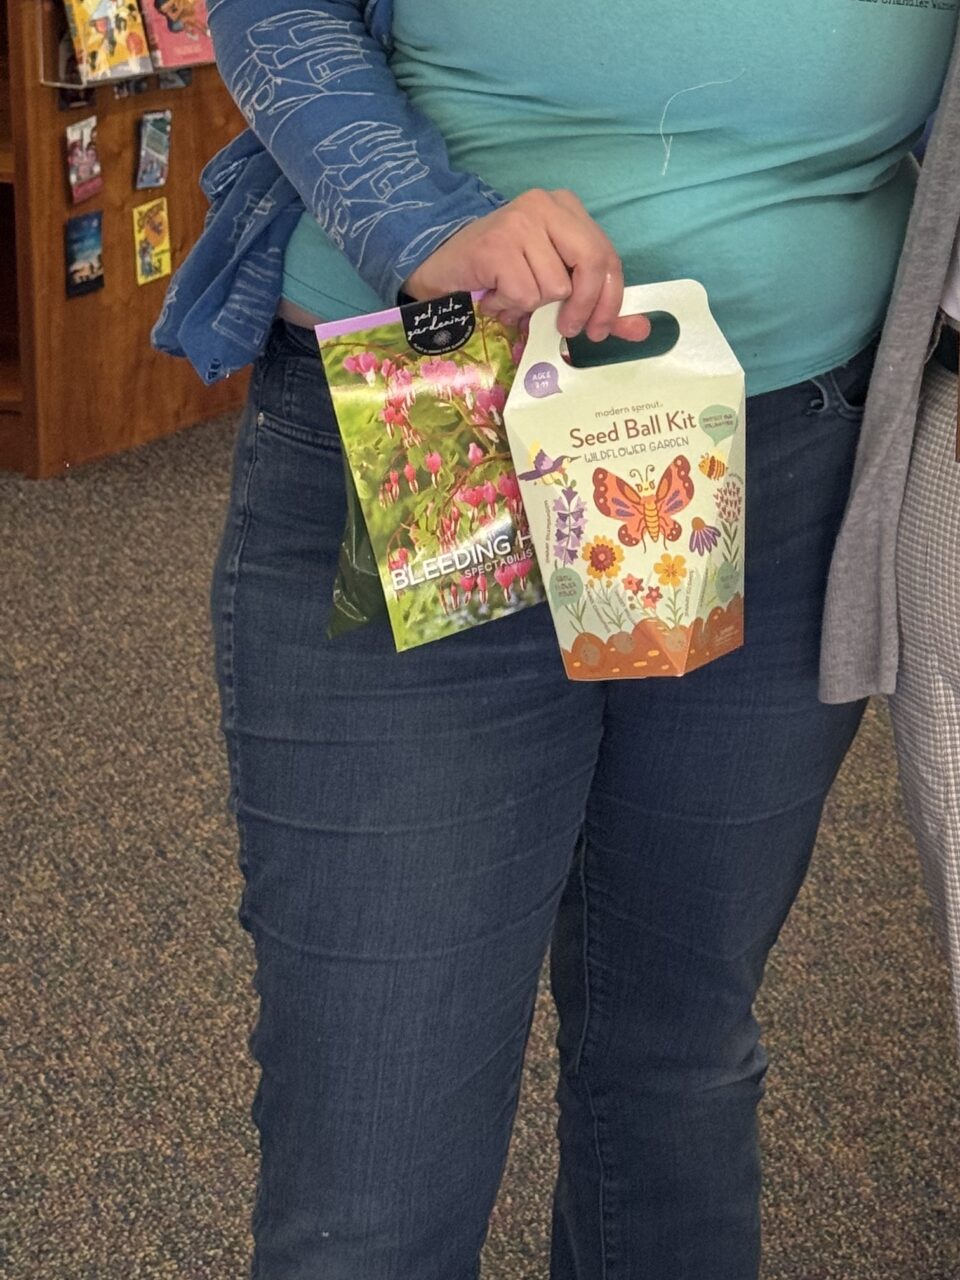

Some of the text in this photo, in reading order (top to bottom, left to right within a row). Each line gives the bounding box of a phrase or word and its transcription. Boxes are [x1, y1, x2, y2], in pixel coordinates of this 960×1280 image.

[414, 297, 462, 326] get into
[407, 315, 471, 341] gardening
[595, 400, 661, 419] modern sprout
[569, 424, 620, 449] Seed
[624, 414, 661, 439] Ball
[666, 410, 697, 432] Kit
[584, 436, 690, 463] WILDFLOWER GARDEN
[391, 535, 511, 591] BLEEDING
